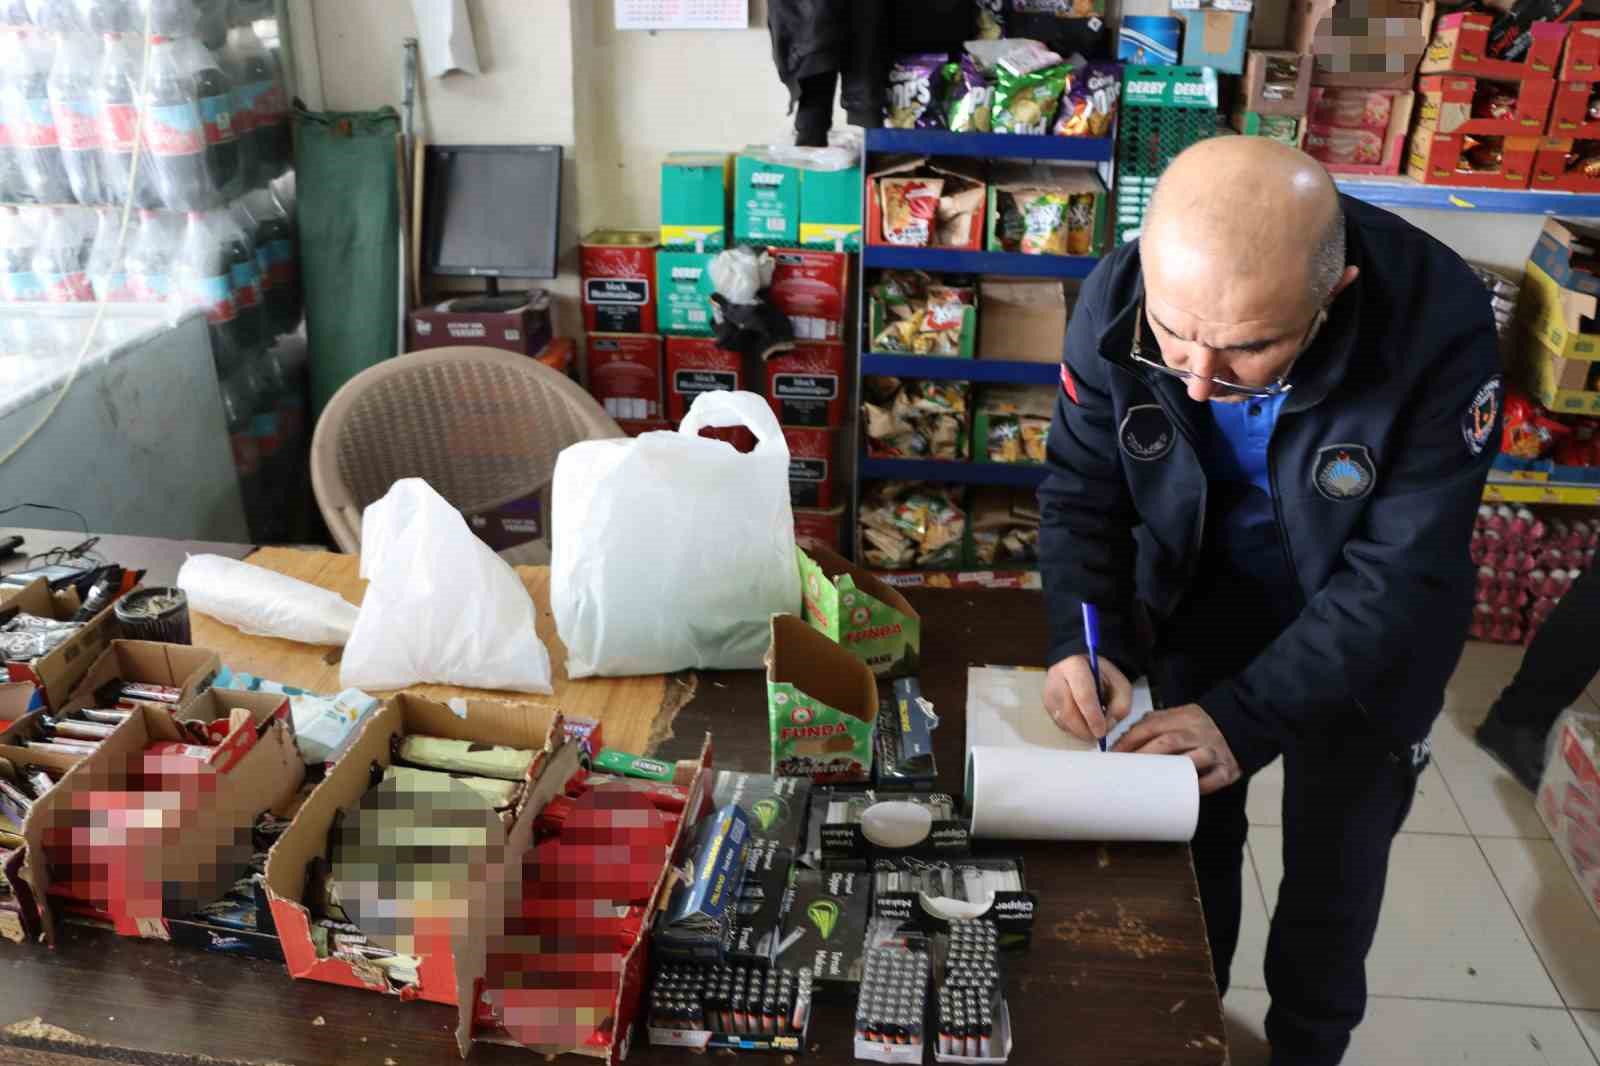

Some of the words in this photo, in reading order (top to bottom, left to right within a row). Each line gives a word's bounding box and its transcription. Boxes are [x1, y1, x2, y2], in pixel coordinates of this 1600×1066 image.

[1127, 80, 1167, 94] DERBY
[1173, 82, 1209, 95] DERB
[847, 623, 902, 641] FUNDA
[780, 722, 848, 741] FUNDA
[995, 900, 1033, 912] Clipper
